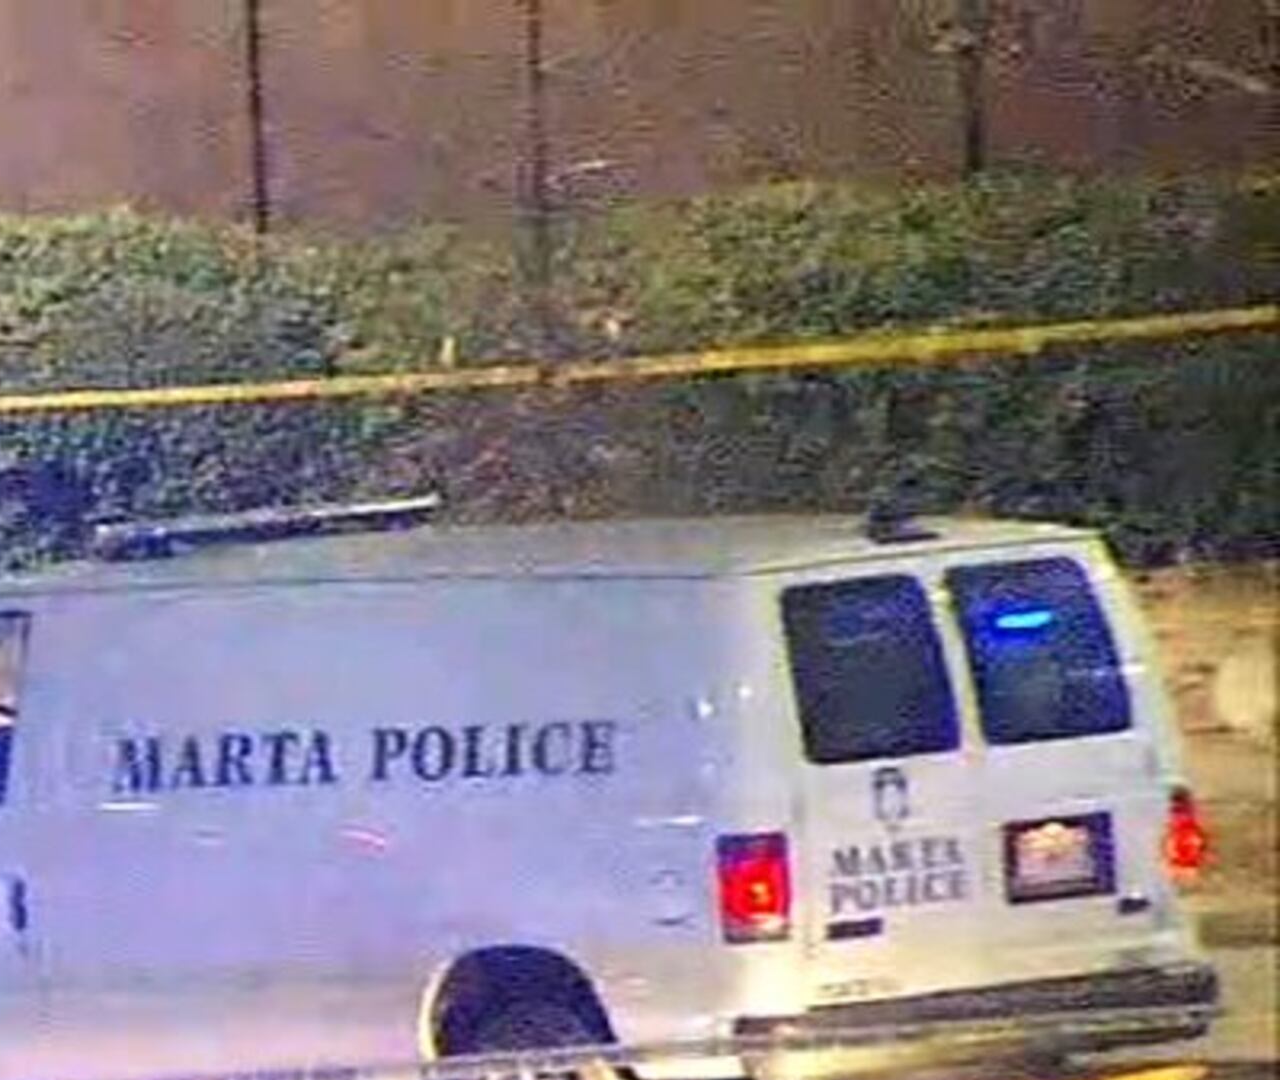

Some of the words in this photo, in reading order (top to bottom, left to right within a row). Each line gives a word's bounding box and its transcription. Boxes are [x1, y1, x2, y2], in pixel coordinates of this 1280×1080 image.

[114, 730, 338, 794] MARTA
[370, 719, 618, 782] POLICE
[831, 838, 964, 877] MARTA
[828, 869, 968, 914] POLICE
